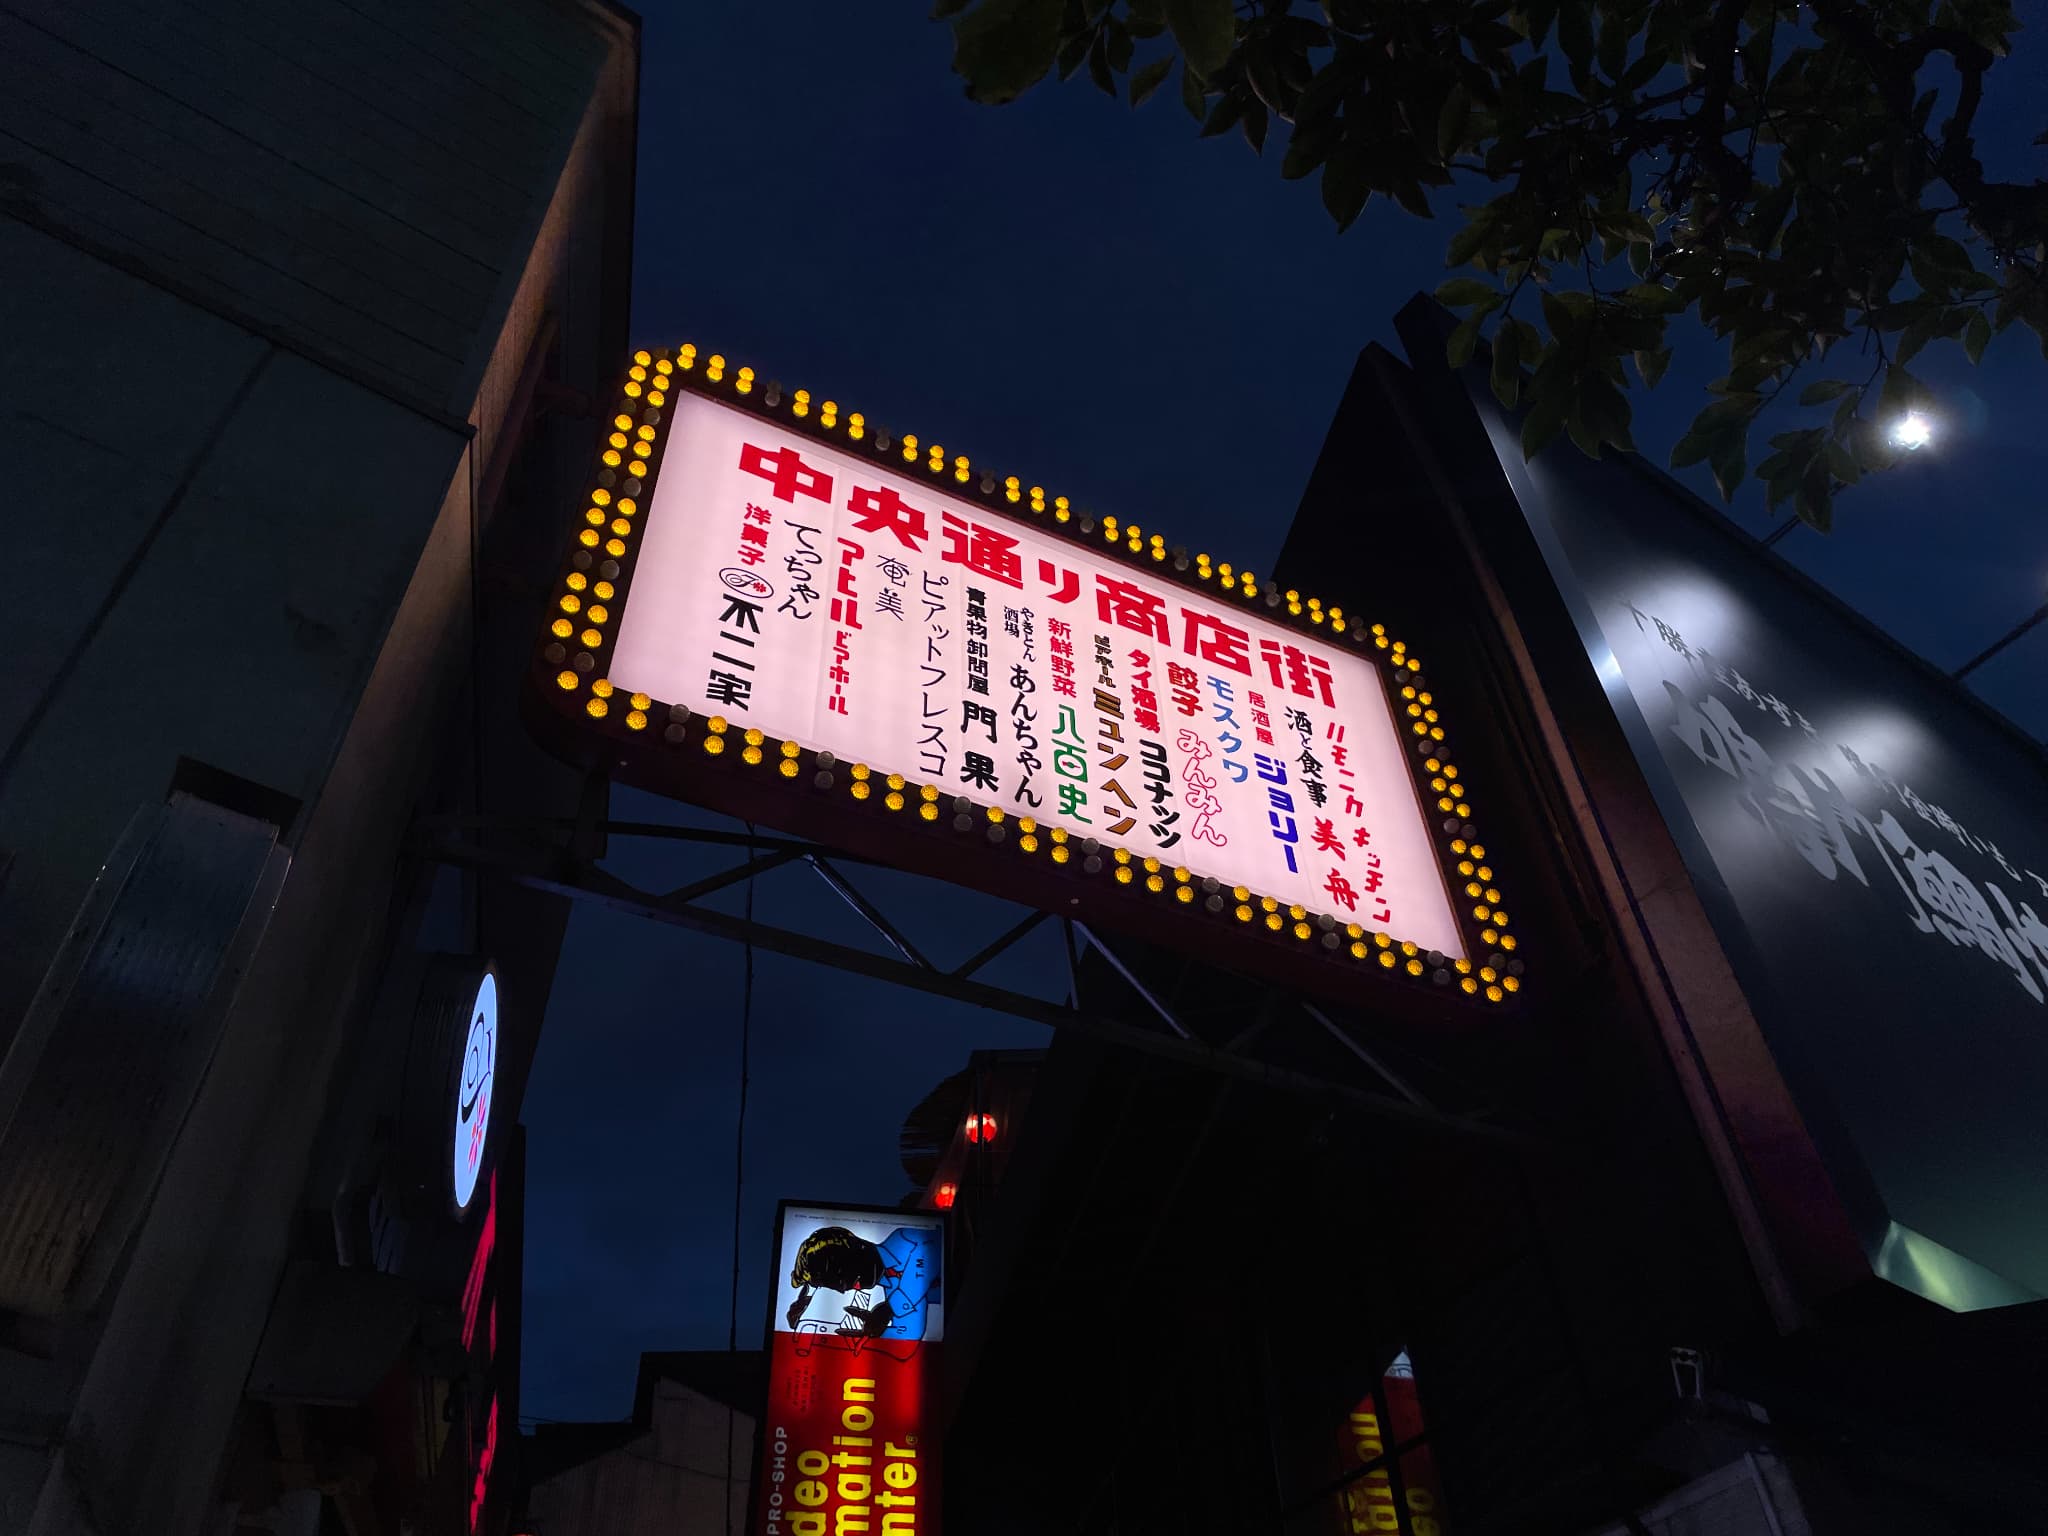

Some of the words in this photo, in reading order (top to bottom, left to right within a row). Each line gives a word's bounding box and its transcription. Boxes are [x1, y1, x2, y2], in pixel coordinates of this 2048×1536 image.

[737, 502, 772, 566] 洋菓子
[738, 442, 1336, 709] 中央通り商店街
[777, 519, 823, 620] てっちゃん
[875, 554, 911, 622] 奄美
[705, 592, 764, 712] 不二家
[916, 569, 950, 777] ピアットフレスコ
[965, 586, 990, 697] 青果物卸問屋
[1019, 606, 1037, 663] やきとん
[1048, 617, 1077, 699] 新鮮野菜
[1166, 661, 1204, 717] 餃子
[959, 700, 1000, 793] 門果
[1009, 663, 1043, 809] あんちゃん
[1127, 648, 1161, 734] タイ酒場
[1206, 674, 1249, 784] モスクワ
[1247, 690, 1275, 747] 居酒屋
[1051, 703, 1093, 825] 八百史
[1092, 687, 1138, 836] ミュンヘン
[1139, 738, 1181, 849] ココナッツ
[1176, 728, 1228, 848] みんみん
[1253, 752, 1299, 874] ジョリー
[1283, 706, 1328, 809] 酒と食事
[1310, 816, 1360, 913] 美舟
